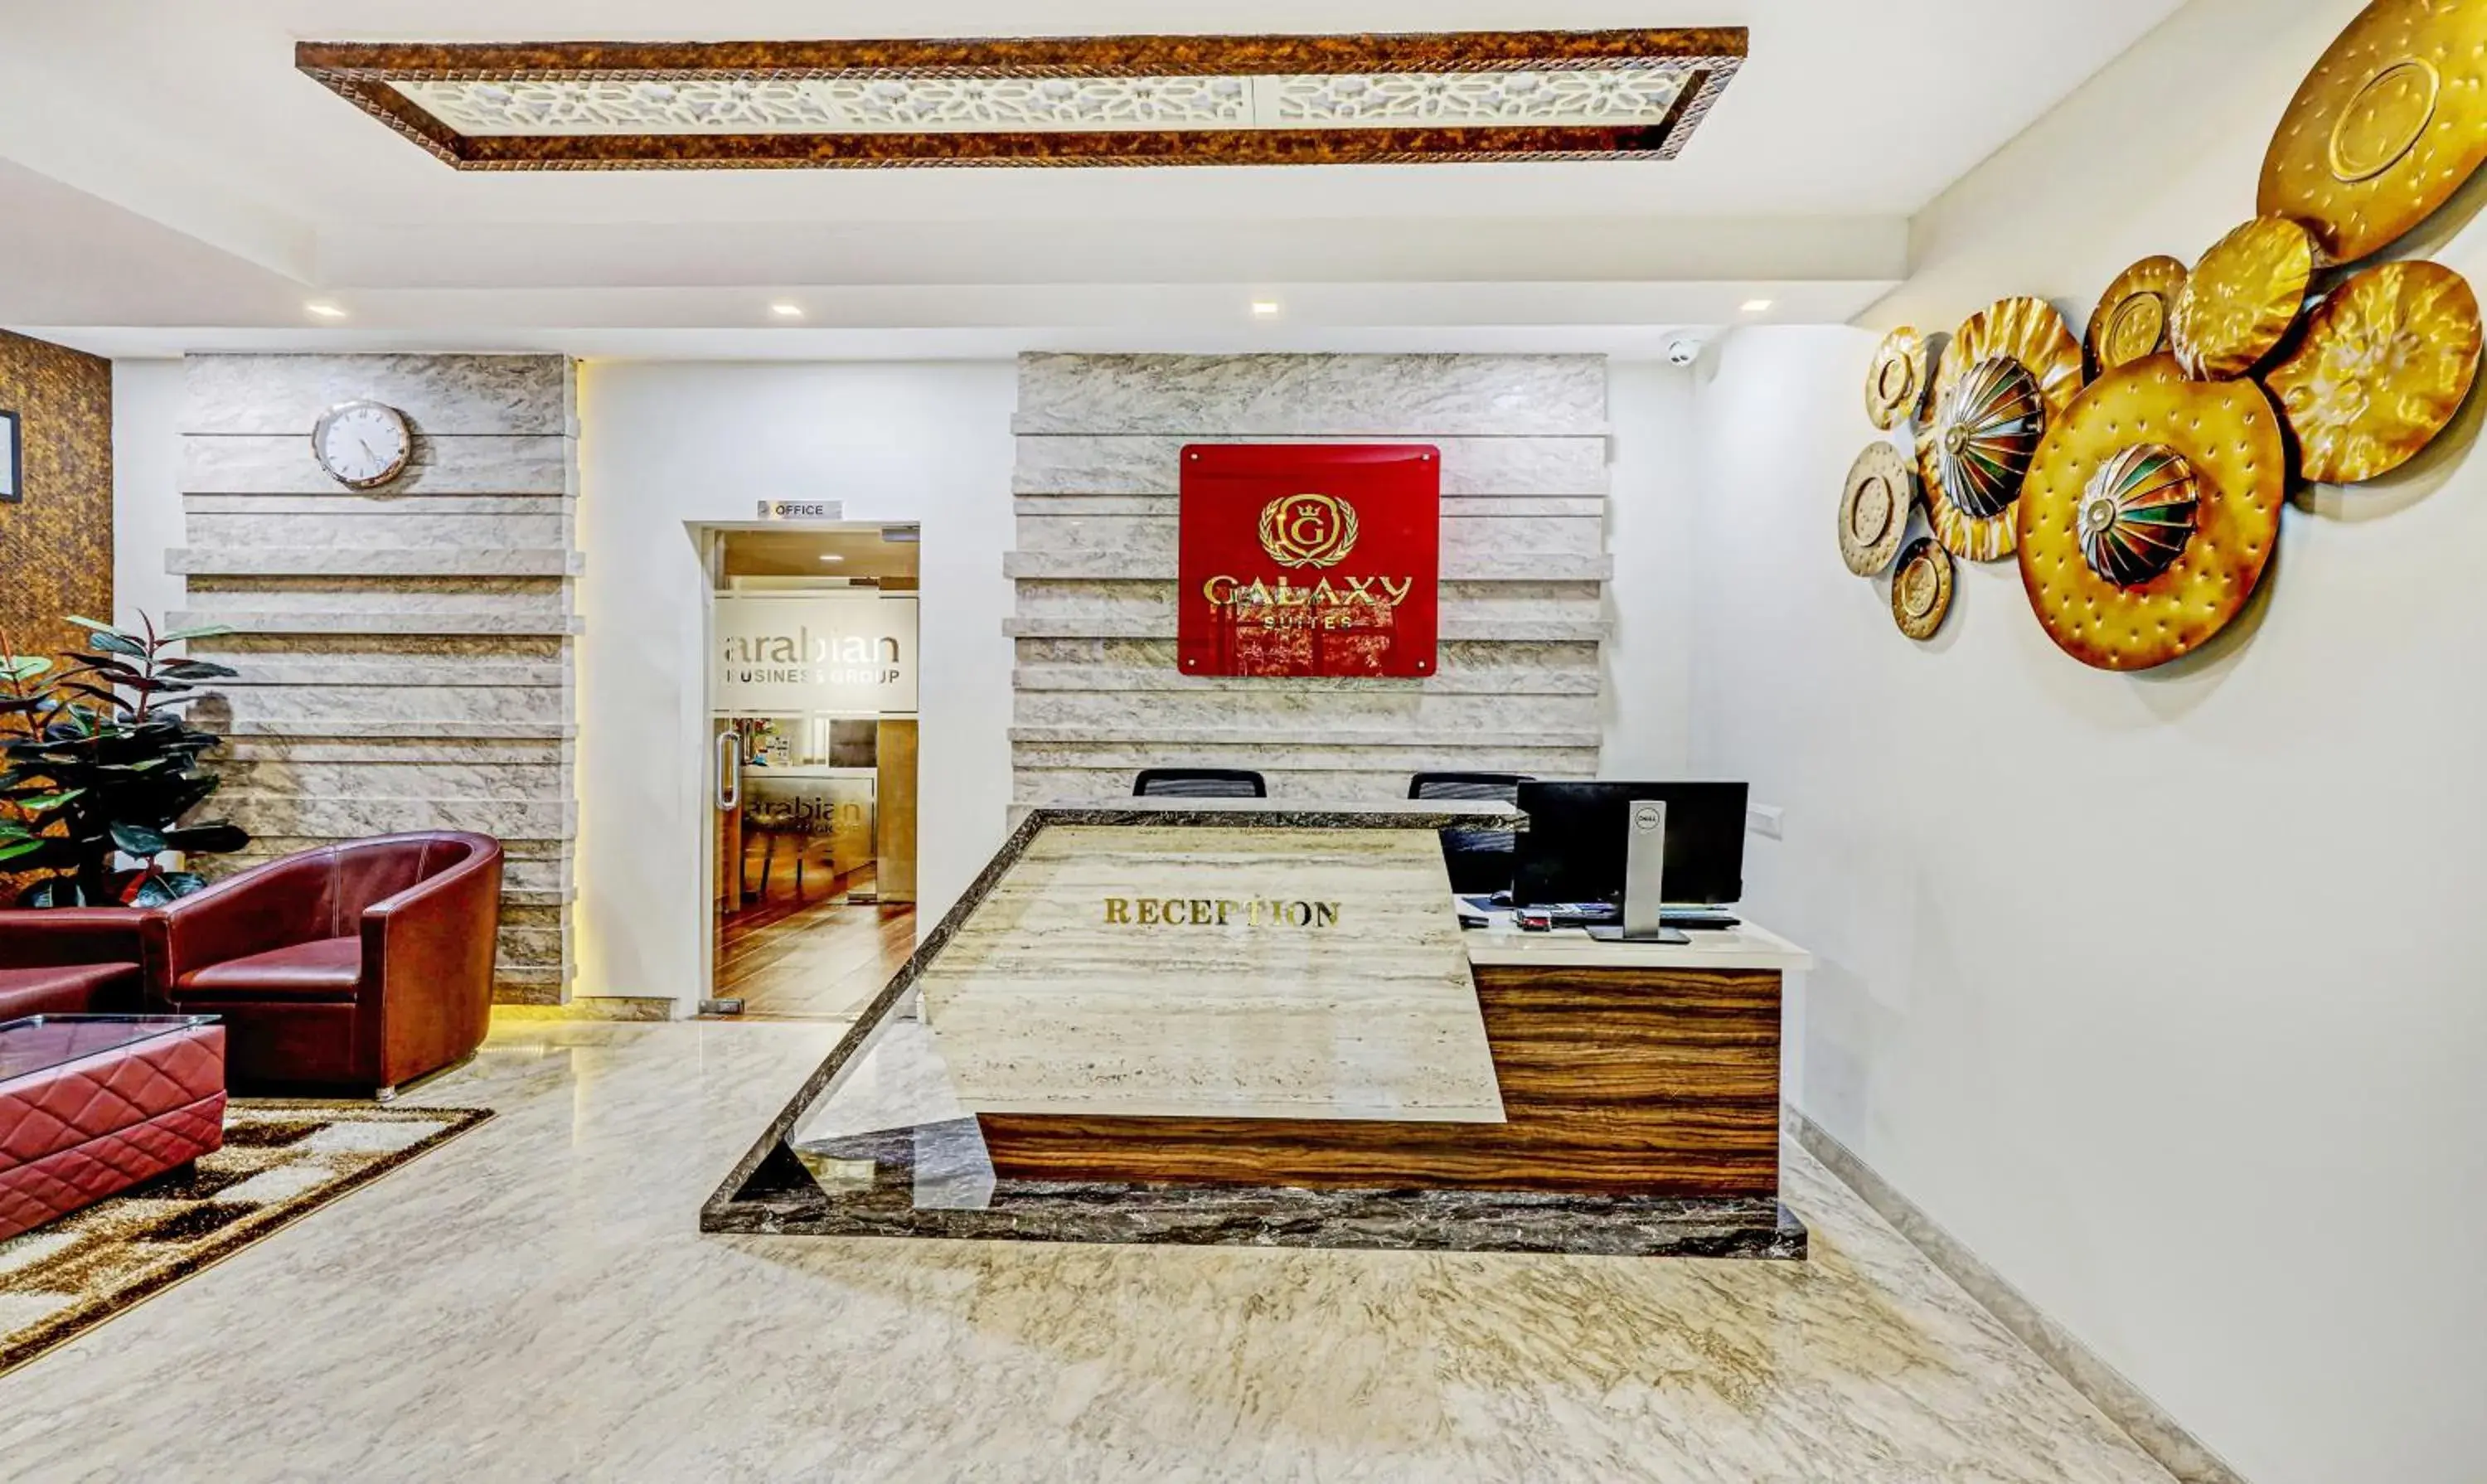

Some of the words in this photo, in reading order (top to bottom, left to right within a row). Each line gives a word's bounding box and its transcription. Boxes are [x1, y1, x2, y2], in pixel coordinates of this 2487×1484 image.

[775, 505, 823, 515] OFFICE
[1291, 516, 1325, 545] G
[1204, 575, 1413, 605] GALAXY
[1263, 616, 1353, 630] SUITES
[725, 625, 899, 663] arabian
[830, 668, 899, 684] GROUP
[1104, 897, 1342, 927] RECEPTION
